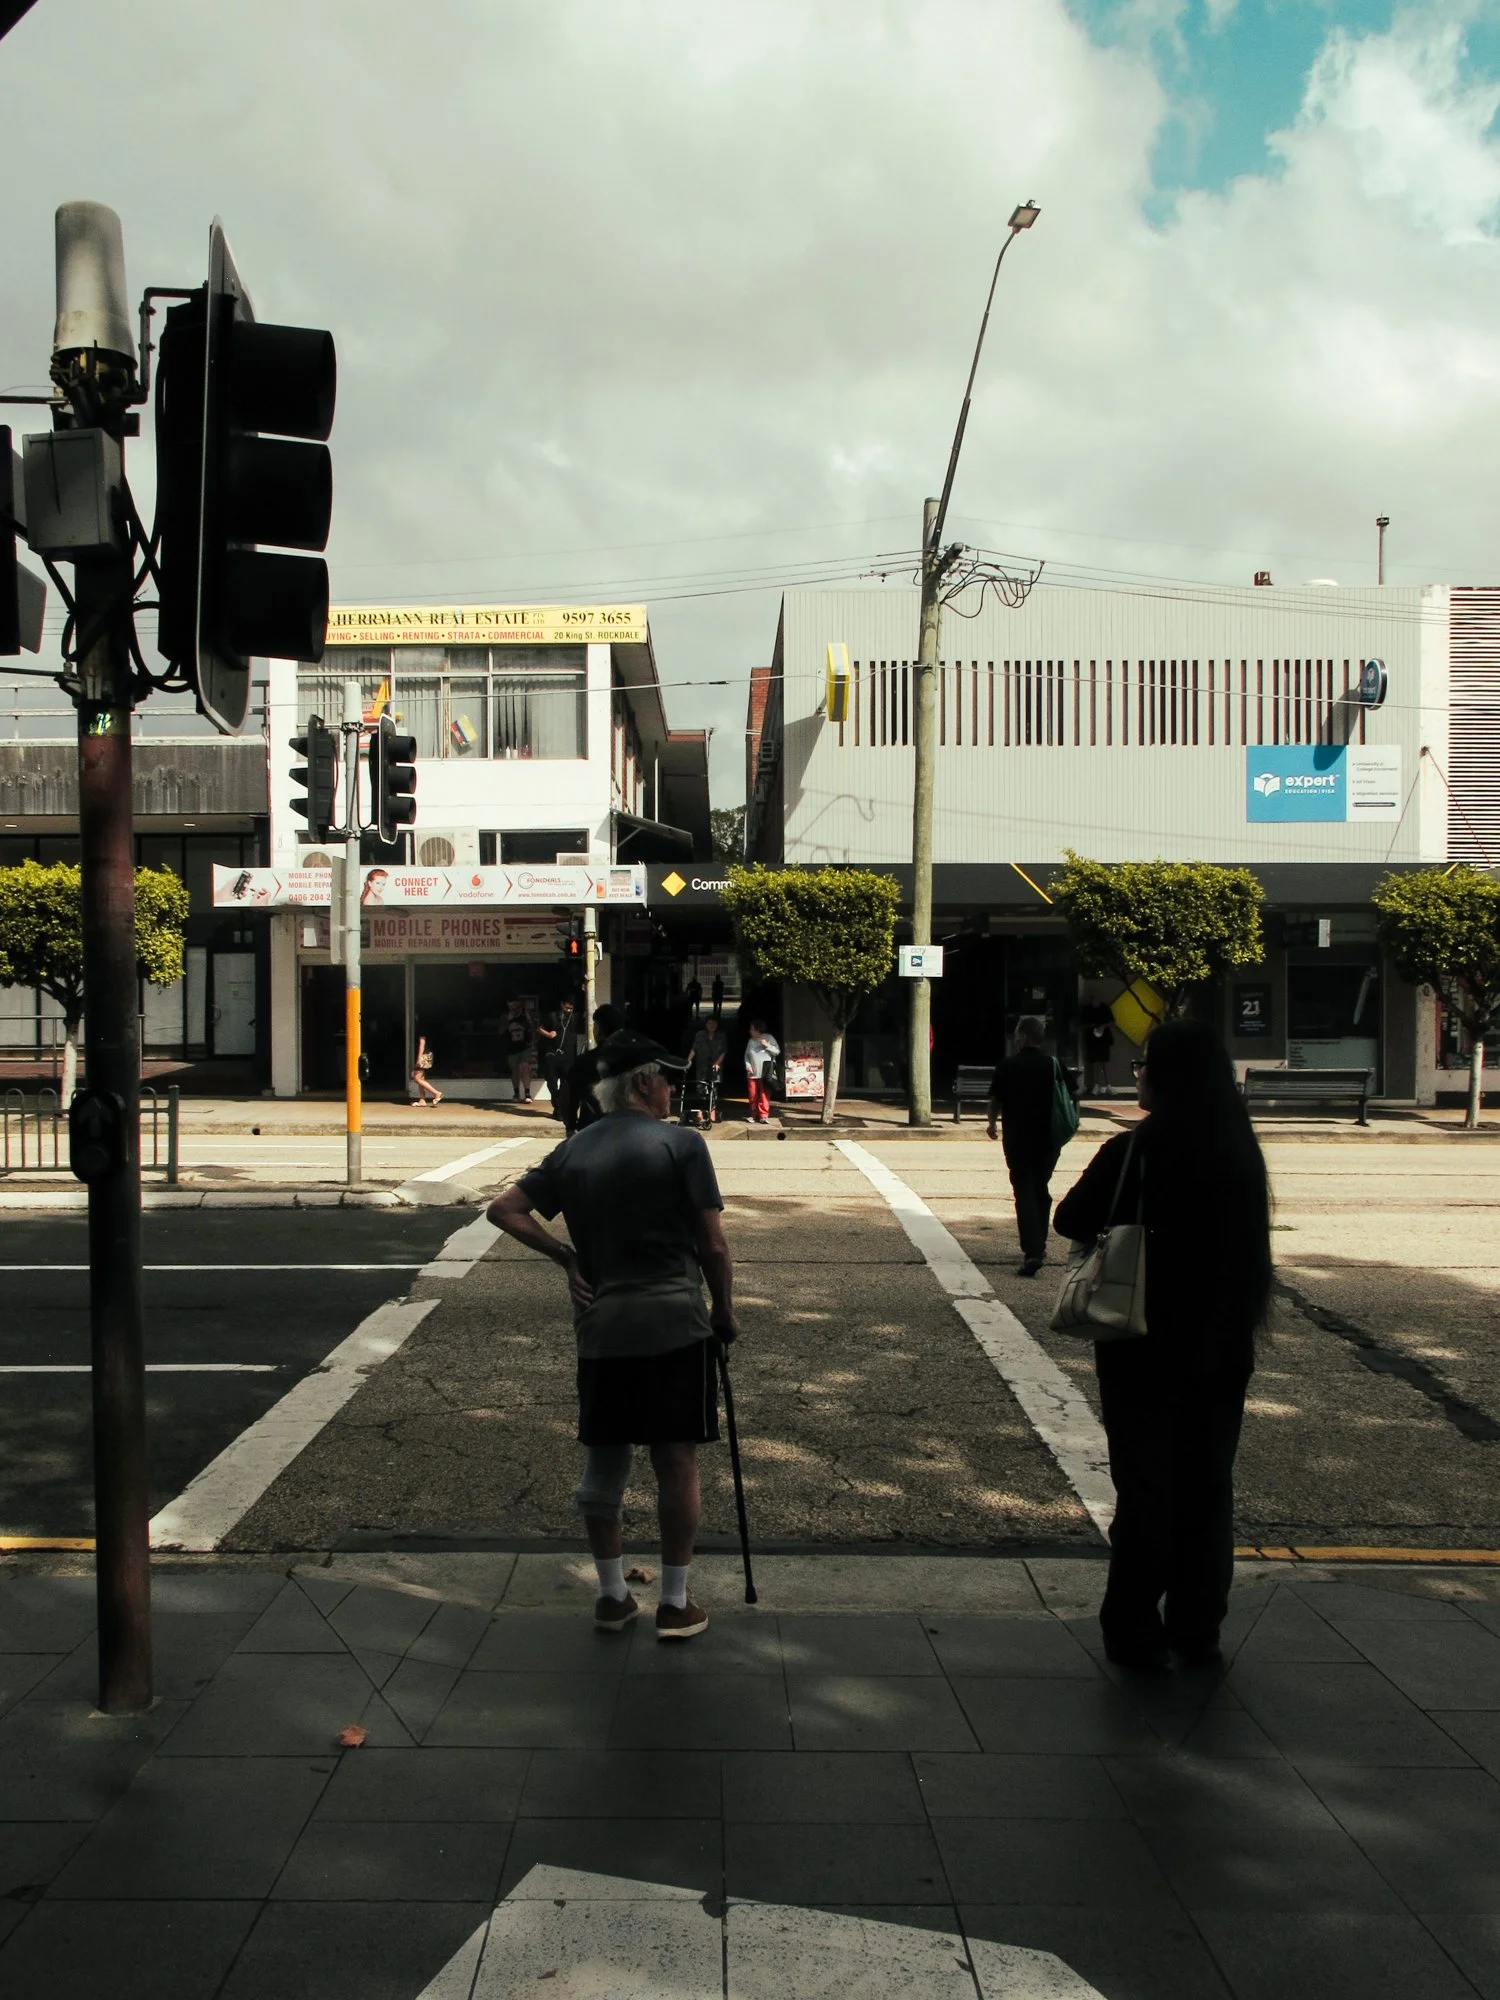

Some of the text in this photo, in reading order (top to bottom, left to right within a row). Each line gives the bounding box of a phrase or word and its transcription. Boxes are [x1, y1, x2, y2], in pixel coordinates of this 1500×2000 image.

[430, 612, 470, 625] REAL
[475, 612, 530, 625] ESTATE
[562, 612, 595, 625] 9597
[599, 612, 632, 625] 3655
[359, 631, 395, 641] SELLING
[402, 631, 440, 640] RENTING
[447, 631, 481, 640] STRATA
[488, 631, 545, 640] COMMERCIAL
[554, 631, 564, 640] 20
[565, 631, 583, 641] King
[597, 631, 640, 640] ROCKDALE
[1285, 774, 1335, 788] expert
[395, 877, 438, 887] CONNECT
[404, 887, 429, 896] HERE
[288, 893, 308, 901] 0406
[310, 893, 324, 901] 204
[374, 919, 501, 937] MOBILE PHONES
[374, 938, 404, 948] MOBILE
[408, 938, 441, 948] REPAIRS
[454, 938, 501, 948] UNLOCKING
[1242, 1000, 1260, 1015] 21
